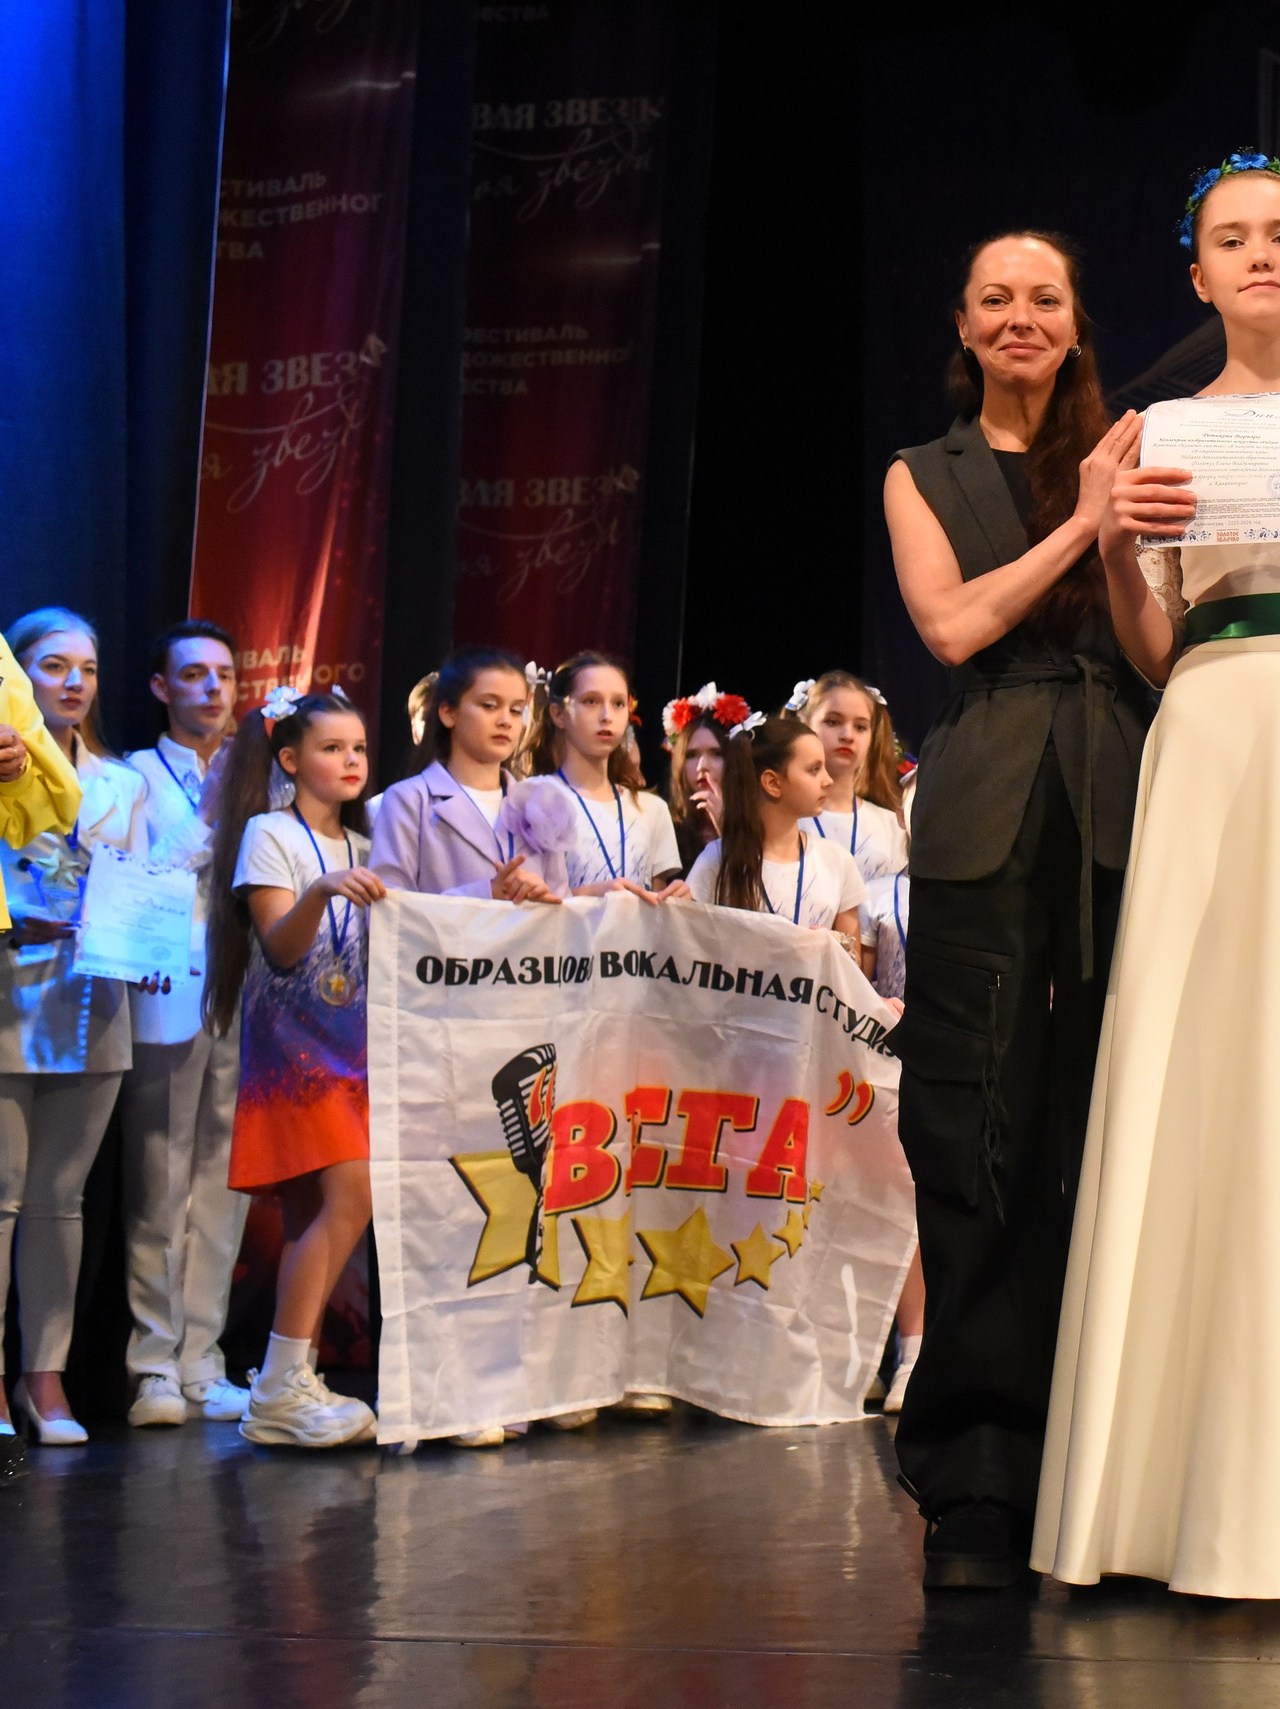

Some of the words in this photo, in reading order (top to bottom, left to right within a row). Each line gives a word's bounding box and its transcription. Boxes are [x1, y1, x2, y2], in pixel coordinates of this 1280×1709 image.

[416, 955, 594, 986] ОБРАЗЦОВ
[600, 950, 814, 1005] ВОКАЛЬНАЯ
[815, 985, 895, 1057] СТУДИ
